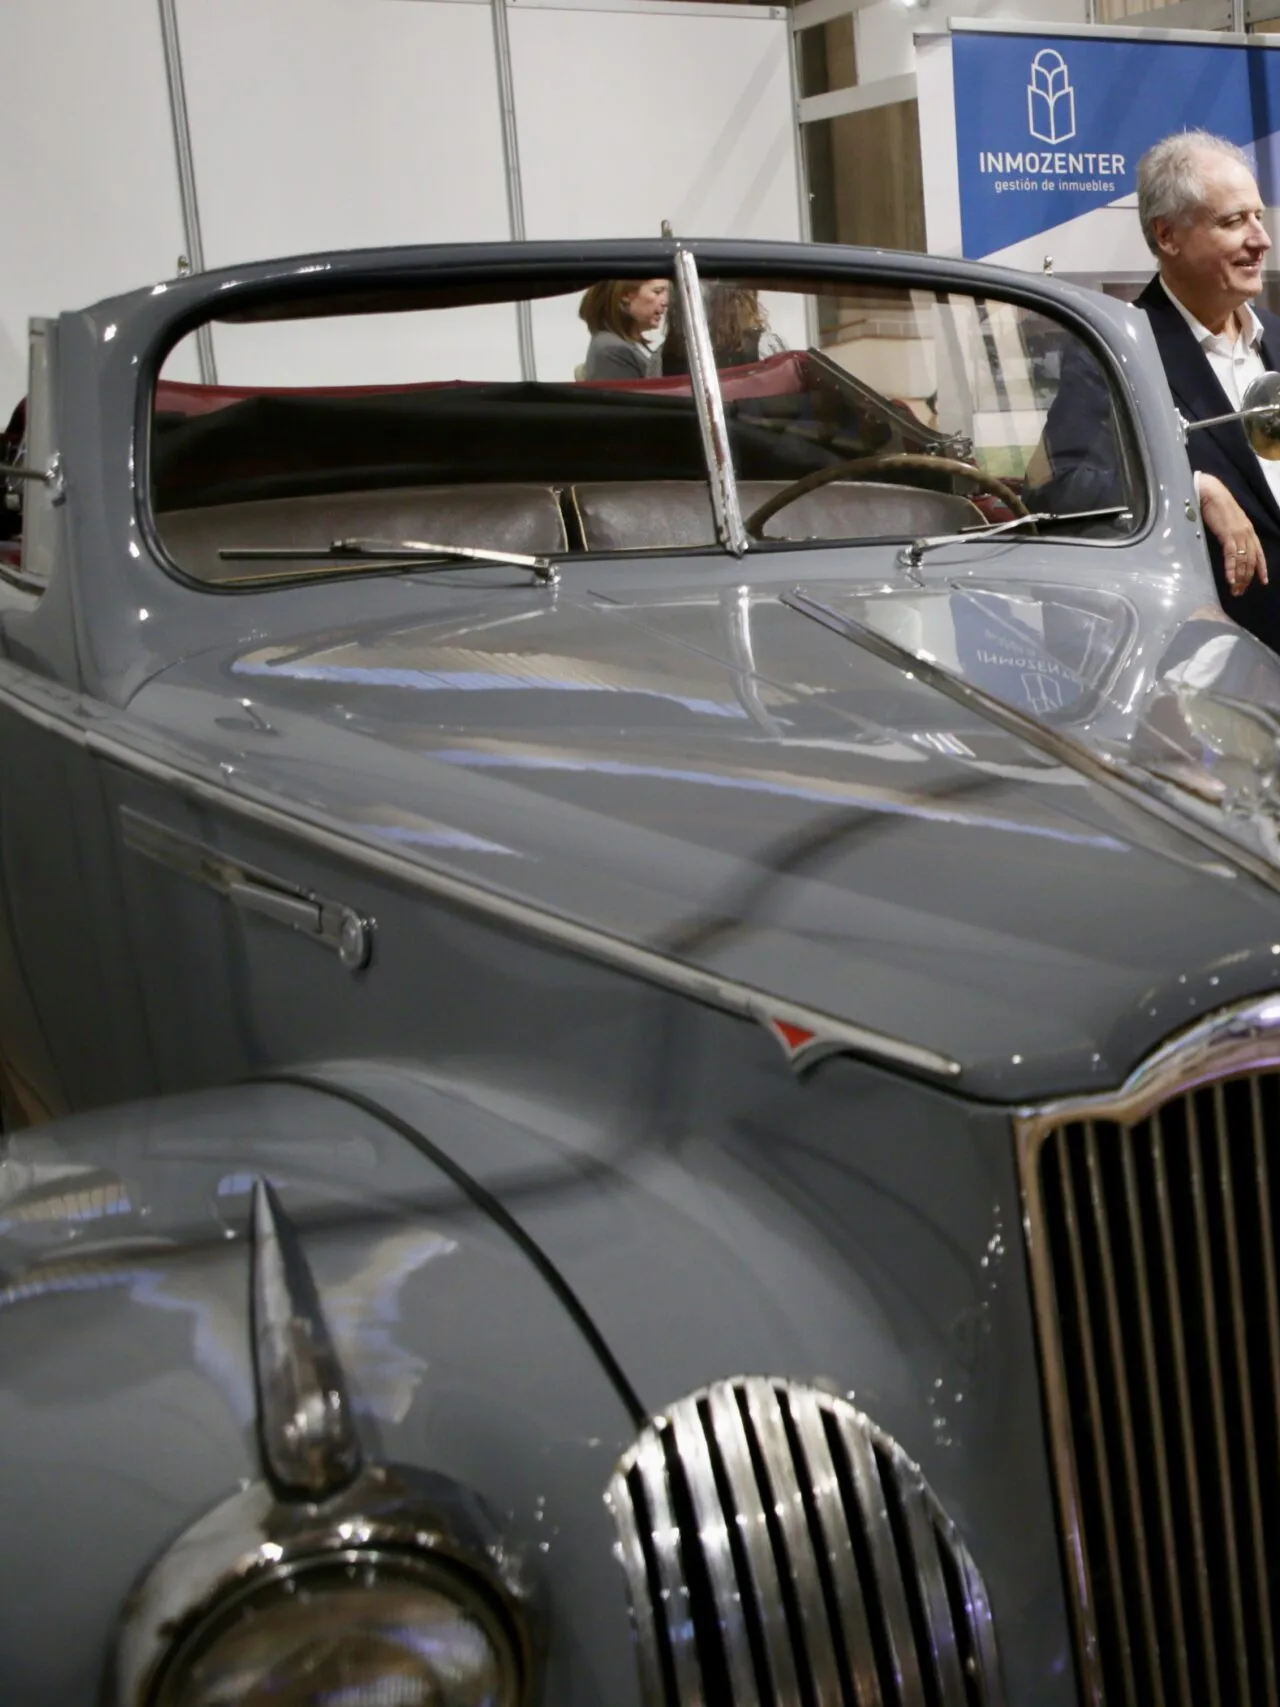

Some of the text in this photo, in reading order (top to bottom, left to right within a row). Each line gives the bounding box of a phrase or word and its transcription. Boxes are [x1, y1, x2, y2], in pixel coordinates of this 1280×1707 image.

[979, 151, 1126, 175] INMOZENTER
[994, 177, 1115, 194] gestión de inmuebles
